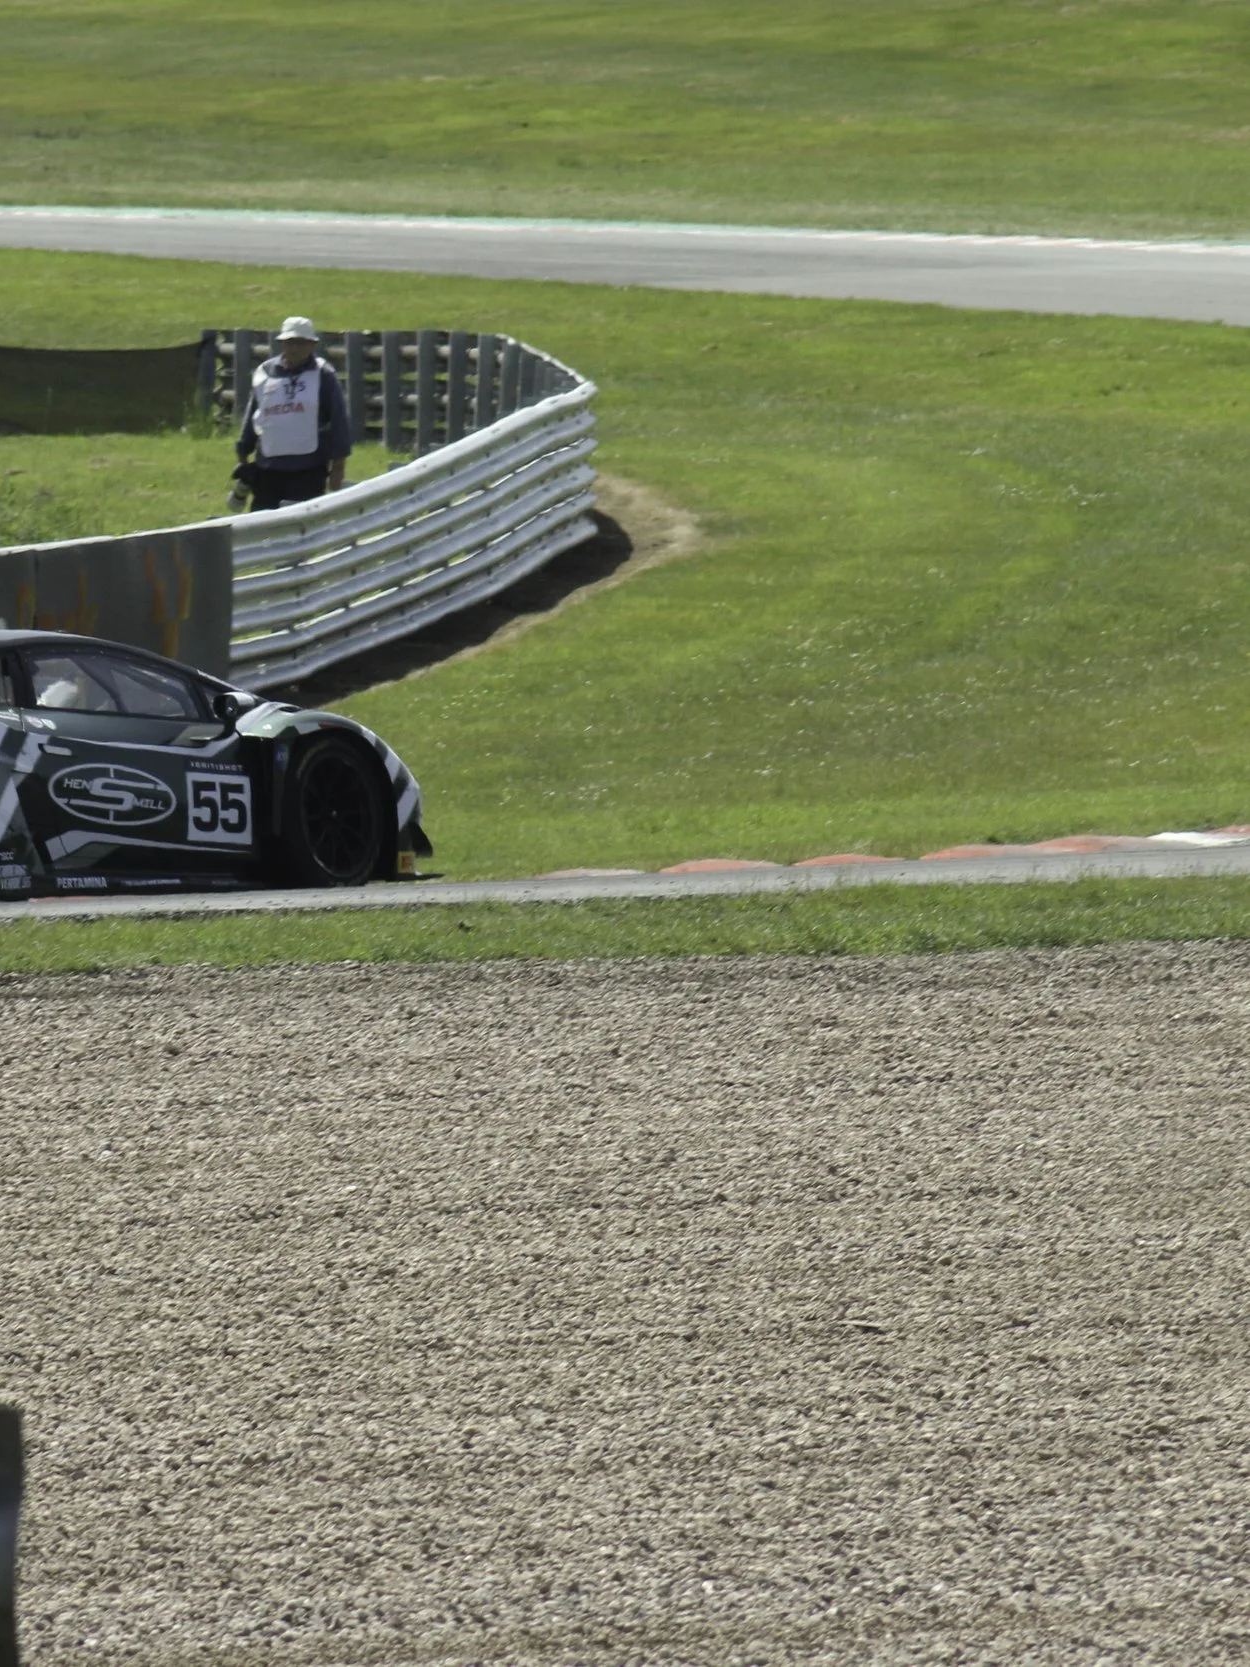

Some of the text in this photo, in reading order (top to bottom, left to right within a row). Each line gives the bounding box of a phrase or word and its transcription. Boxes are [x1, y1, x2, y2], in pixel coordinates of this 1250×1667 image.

[264, 402, 304, 416] MEDIA
[191, 780, 248, 834] 55
[55, 876, 108, 889] PERTAMINA
